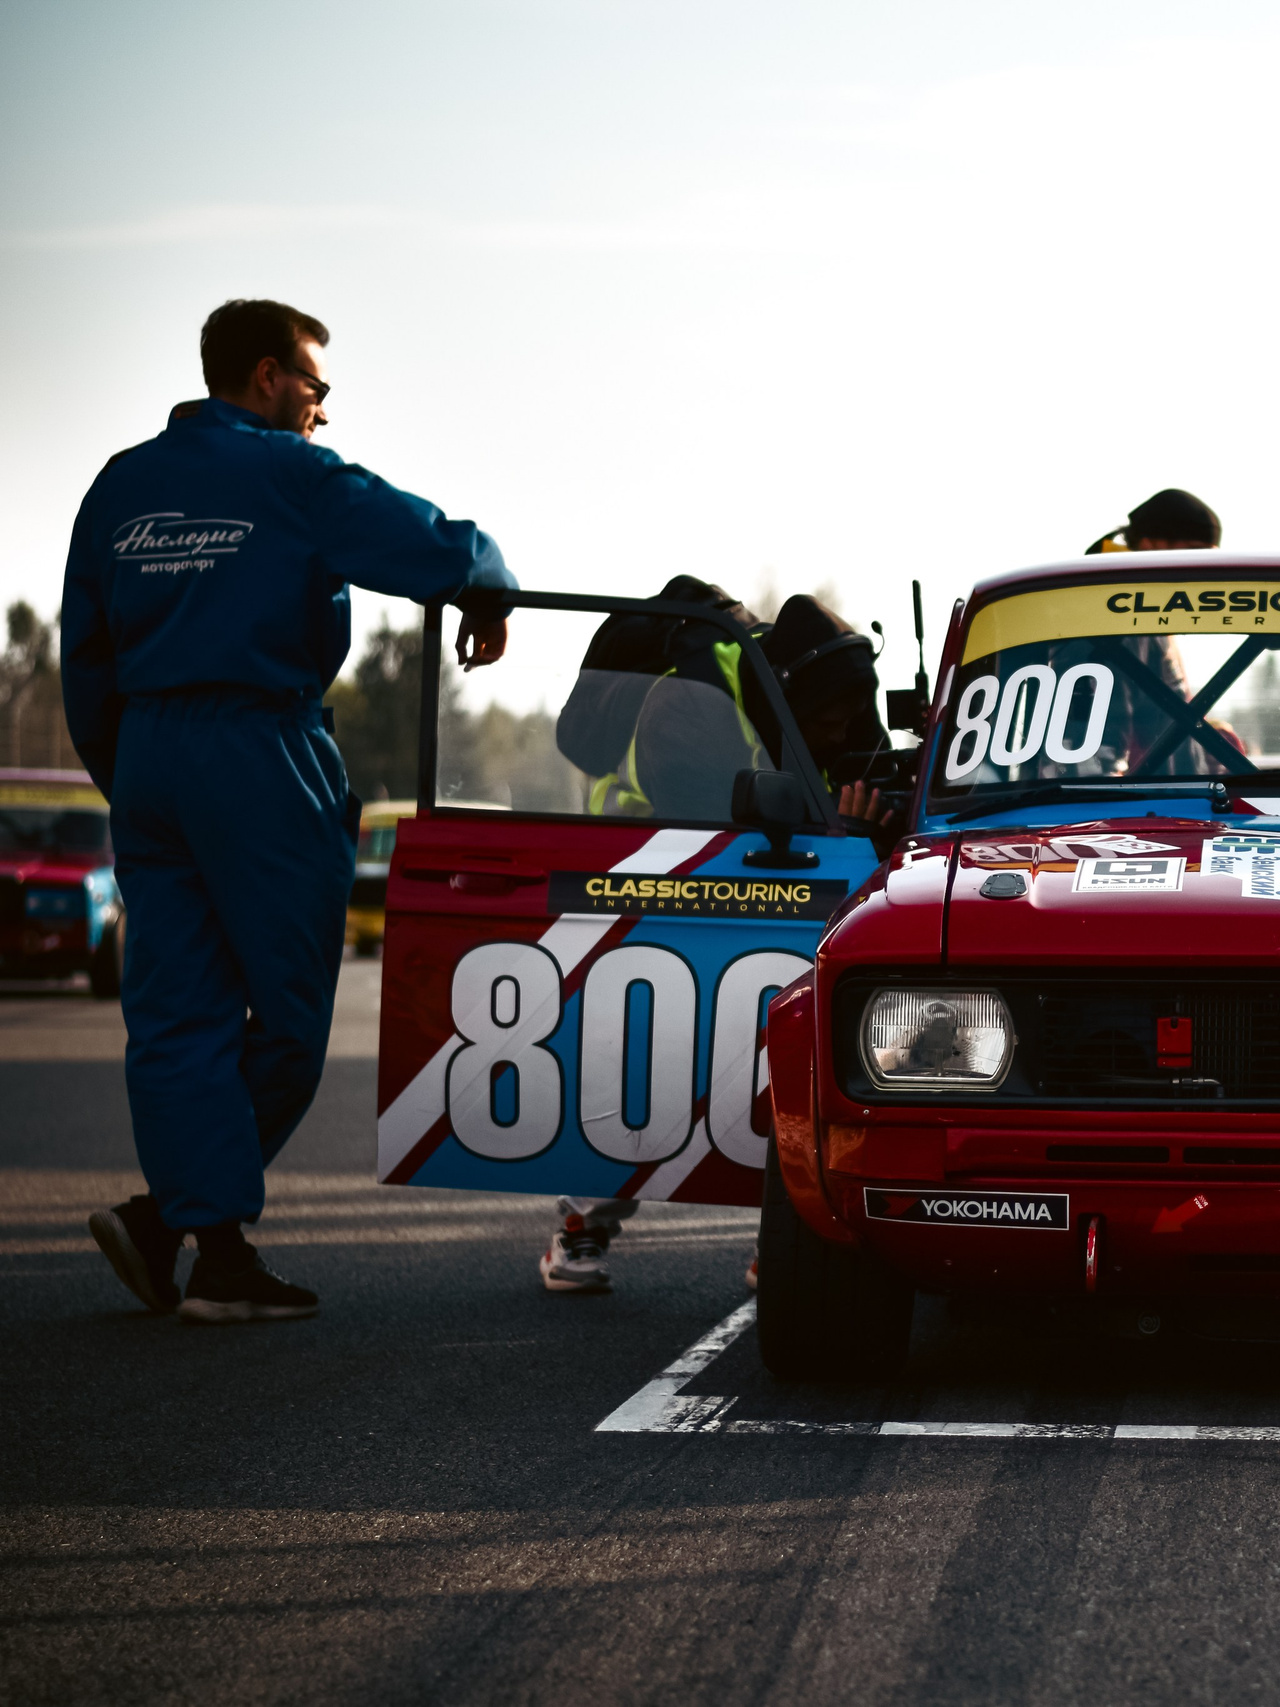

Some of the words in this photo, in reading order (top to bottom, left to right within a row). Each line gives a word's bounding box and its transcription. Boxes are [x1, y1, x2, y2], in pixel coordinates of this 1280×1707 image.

[945, 662, 1115, 781] 800
[593, 899, 800, 914] INTERNATIONAL
[445, 941, 815, 1169] 800
[921, 1198, 1052, 1221] YOKOHAMA
